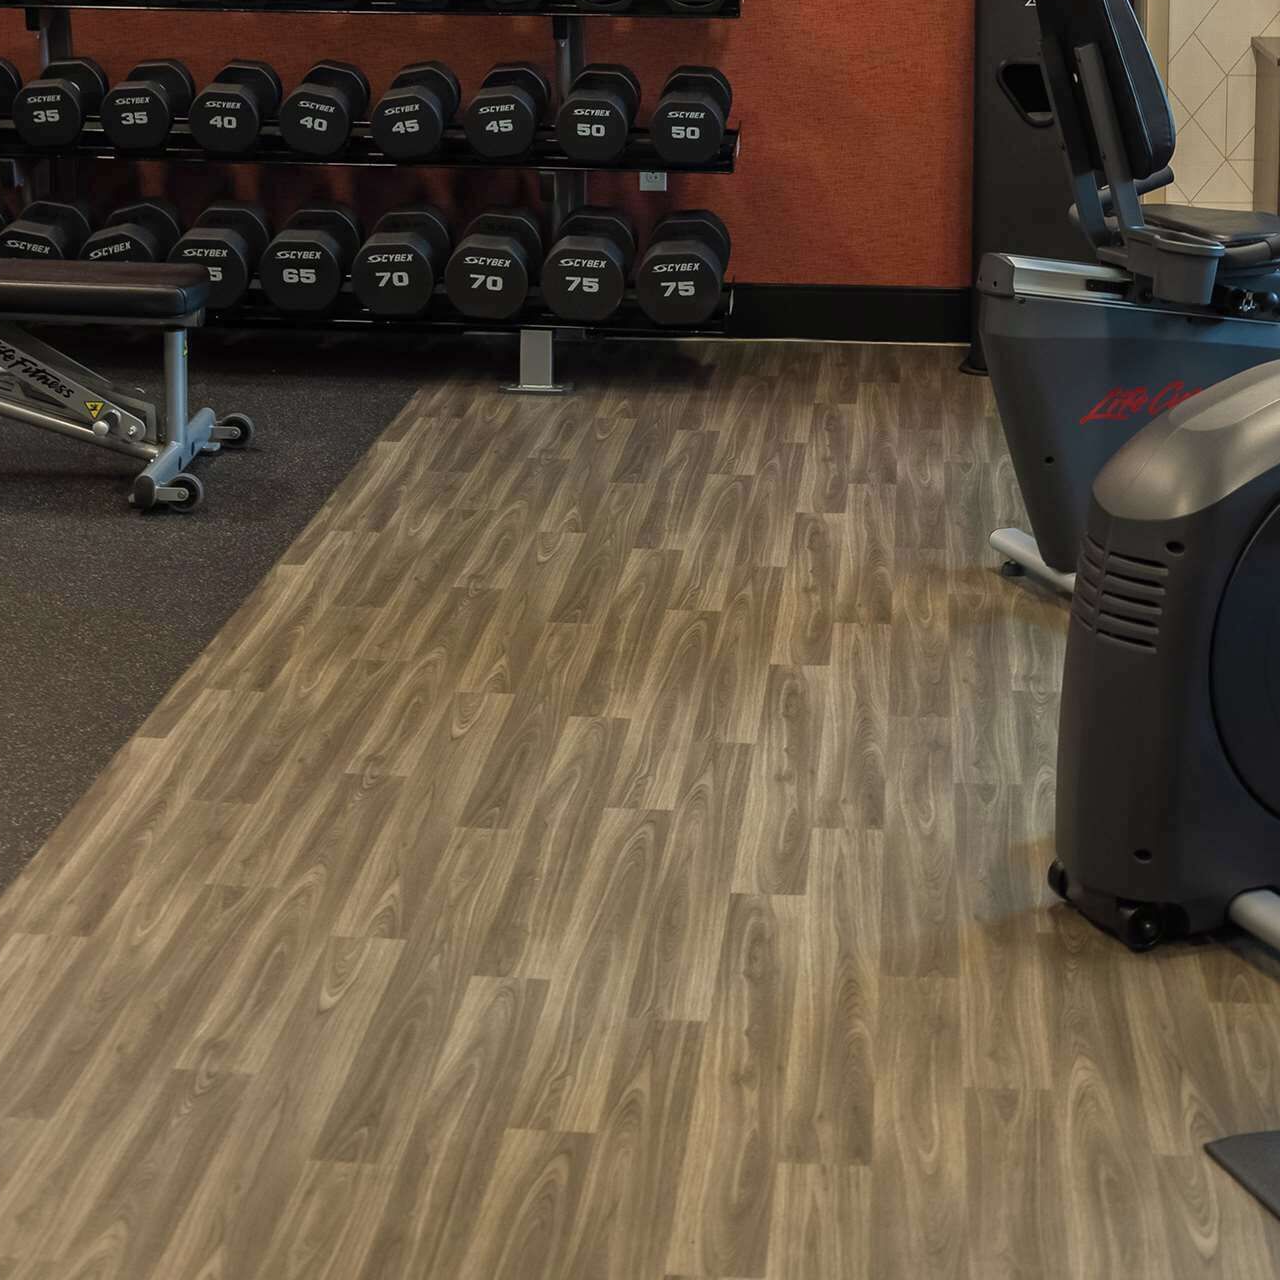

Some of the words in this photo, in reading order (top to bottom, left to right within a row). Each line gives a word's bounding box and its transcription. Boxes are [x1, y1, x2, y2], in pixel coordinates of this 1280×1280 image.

[33, 110, 59, 122] 35
[121, 112, 147, 124] 35
[210, 116, 236, 128] 40
[300, 117, 327, 131] 40
[392, 120, 419, 133] 45
[486, 120, 513, 132] 45
[577, 124, 605, 136] 50
[672, 127, 699, 139] 50
[283, 269, 316, 283] 65
[376, 272, 408, 286] 70
[470, 274, 502, 290] 70
[566, 277, 599, 292] 75
[661, 281, 695, 296] 75
[8, 357, 75, 399] Fitness
